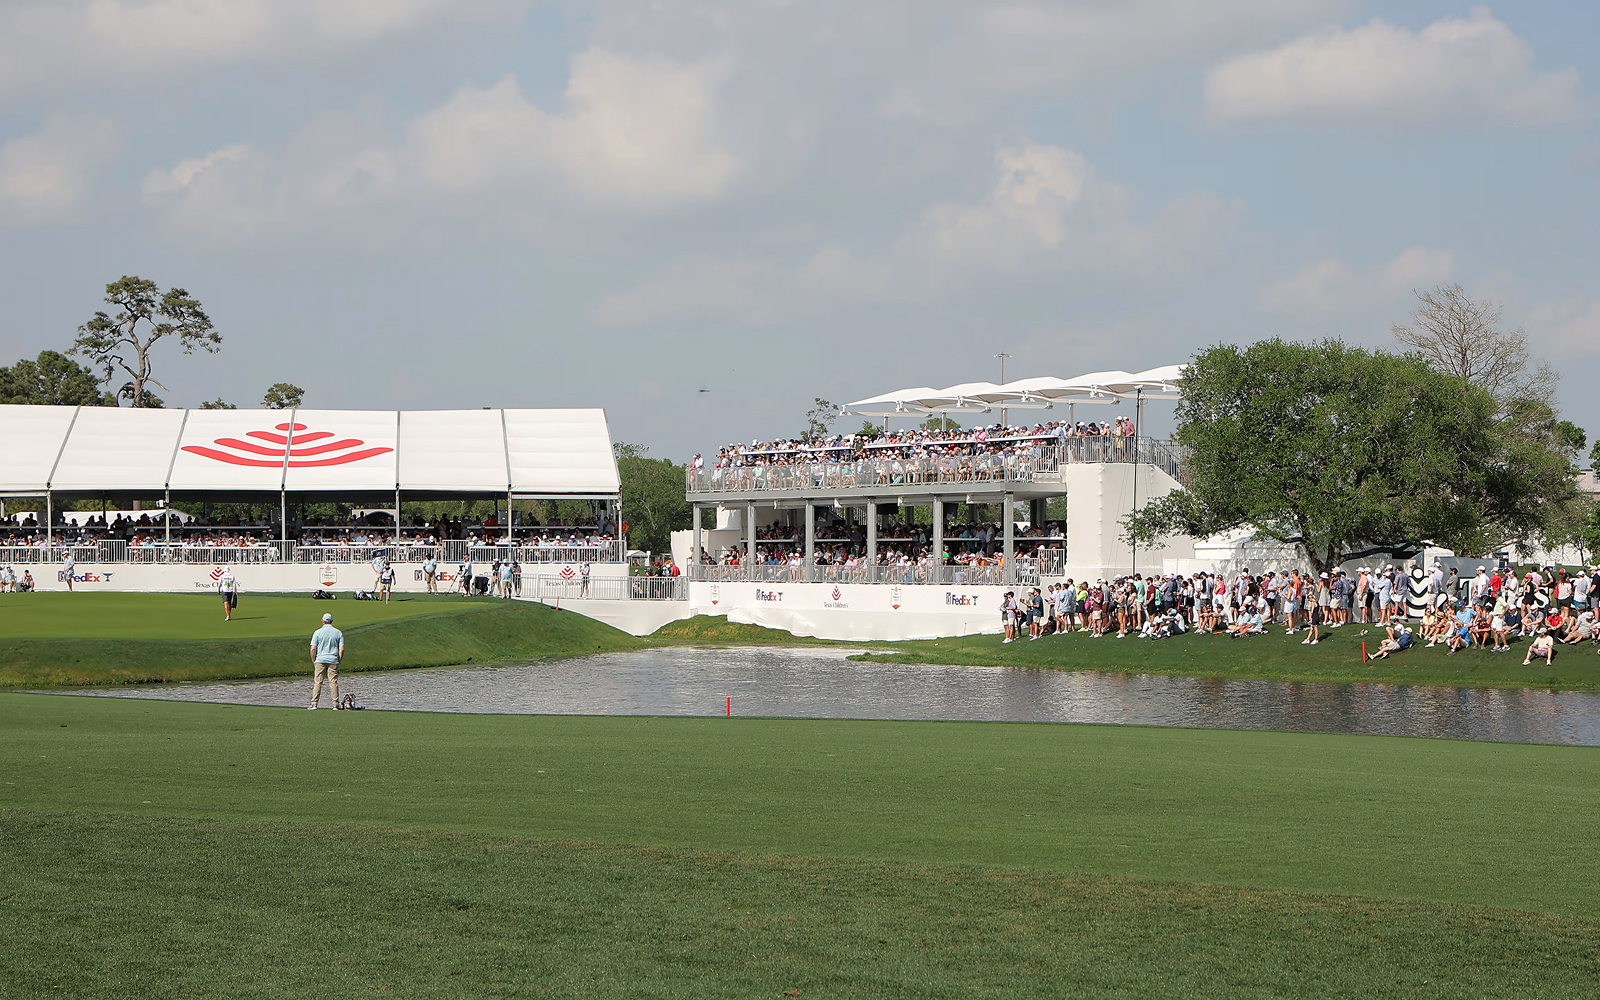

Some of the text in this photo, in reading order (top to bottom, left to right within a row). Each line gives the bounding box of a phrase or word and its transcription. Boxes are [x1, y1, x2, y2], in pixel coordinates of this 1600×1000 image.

[70, 573, 100, 582] edEx
[761, 591, 776, 601] FedEx
[952, 594, 971, 605] FedEx
